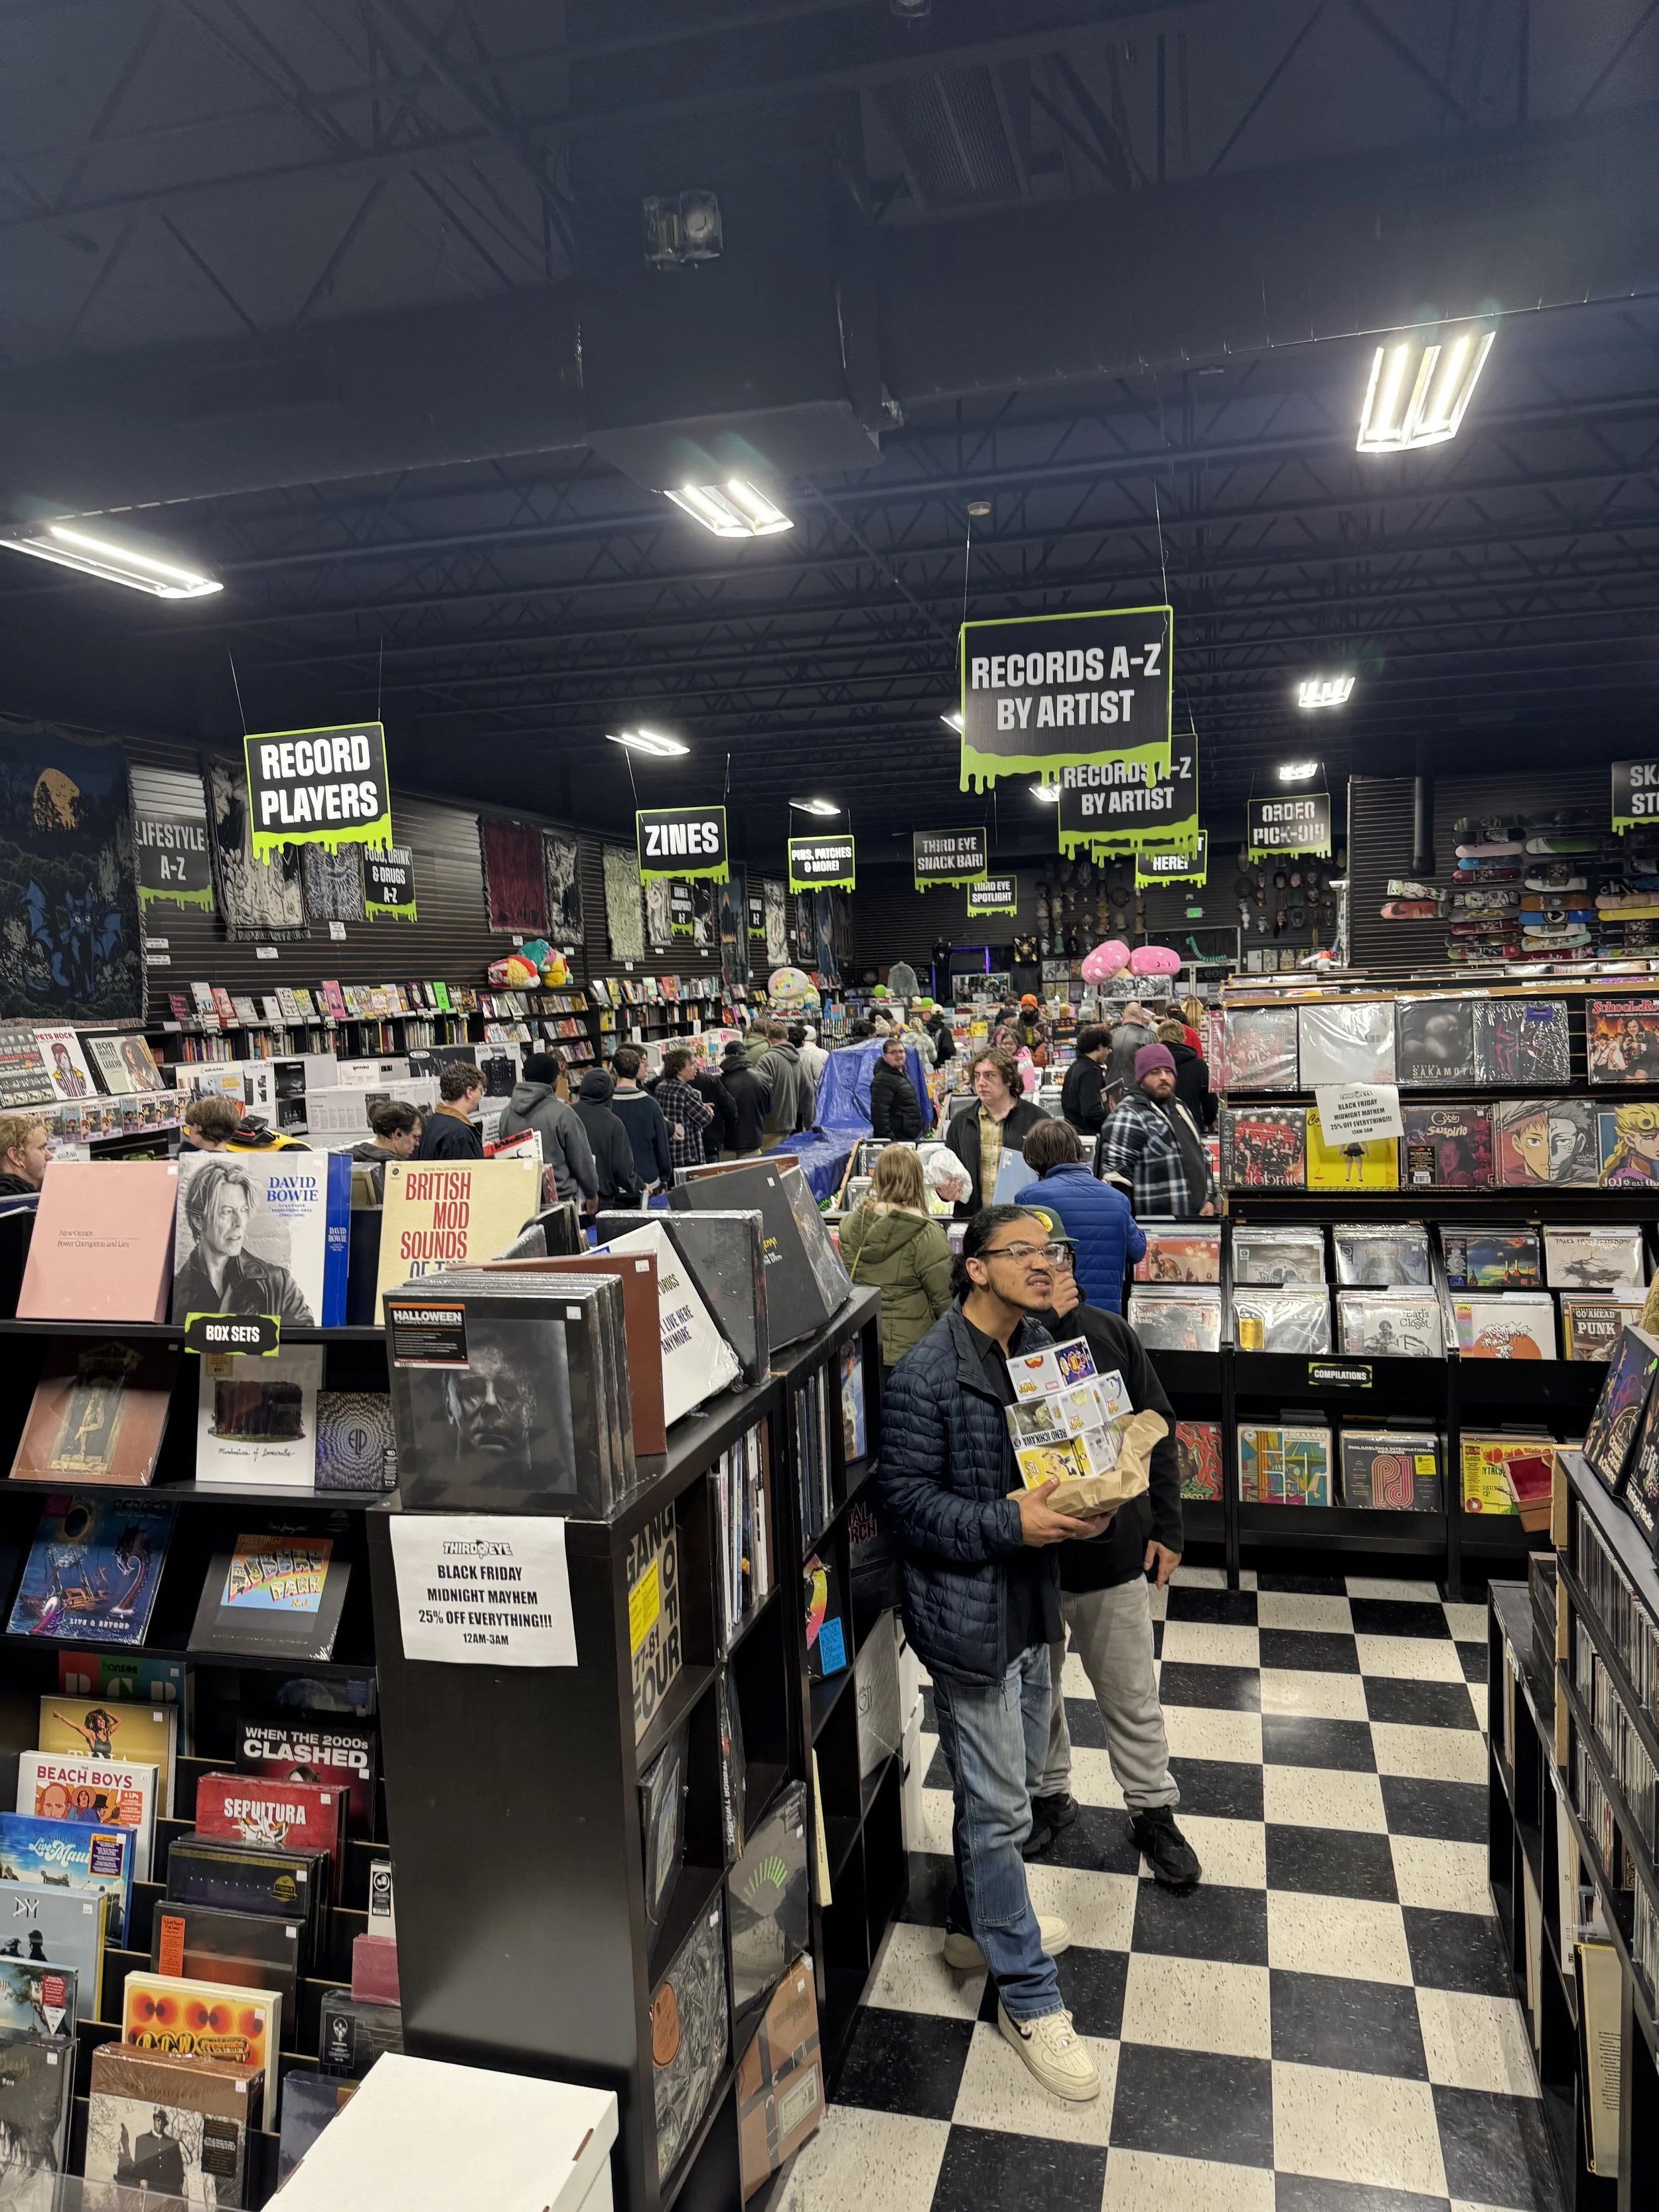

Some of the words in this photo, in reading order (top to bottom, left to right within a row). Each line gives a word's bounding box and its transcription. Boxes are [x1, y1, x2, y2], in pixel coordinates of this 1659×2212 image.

[971, 648, 1104, 690] RECORDS
[1110, 643, 1161, 679] A-Z
[997, 696, 1032, 731] BY
[1037, 689, 1135, 729] ARTIST
[260, 735, 370, 779] RECORD
[1630, 764, 1659, 786] SK
[261, 780, 378, 826] PLAYERS
[1082, 793, 1106, 815] BY
[1108, 787, 1175, 813] ARTIST
[1262, 801, 1315, 822] ORDER
[135, 820, 206, 852] LIFESTYLE
[644, 822, 719, 856] ZINES
[922, 838, 956, 853] THIRD
[958, 837, 977, 851] EYE
[792, 849, 814, 861] PINS,
[815, 846, 852, 859] PATCHES
[917, 855, 956, 871] SNACK
[957, 853, 983, 868] BAR!
[161, 855, 186, 881] A-Z
[372, 865, 379, 882] &
[380, 866, 405, 885] DRUGS
[804, 861, 812, 873] &
[812, 860, 839, 872] MORE!
[384, 887, 398, 903] A-Z
[997, 881, 1011, 891] EYE
[972, 892, 1012, 903] SPOTLIGHT
[1592, 1001, 1634, 1014] School
[1412, 1067, 1474, 1076] SAKAMOTO
[1334, 1111, 1360, 1120] MIDNIGHT
[1362, 1107, 1385, 1116] MAYHEM
[1338, 1102, 1357, 1110] BLACK
[1358, 1099, 1377, 1108] FRIDAY
[1307, 1114, 1320, 1126] Co
[1354, 1116, 1392, 1127] EVERYTHING!!!
[269, 1176, 317, 1189] DAVID
[405, 1172, 472, 1201] BRITISH
[266, 1189, 319, 1202] BOWIE
[433, 1202, 469, 1229] MOD
[400, 1231, 467, 1260] SOUNDS
[659, 1273, 680, 1294] DRUGS
[393, 1310, 463, 1322] HALLOWEEN
[664, 1313, 679, 1332] LIVE
[678, 1305, 693, 1324] HERE
[206, 1324, 230, 1342] BOX
[231, 1325, 260, 1343] SETS
[1577, 1322, 1616, 1335] PUNK
[661, 1326, 692, 1355] ANYMORE
[1314, 1369, 1367, 1380] COMPILATIONS
[1022, 1431, 1051, 1446] ICHIKAWA
[1052, 1428, 1067, 1441] RENO
[443, 1541, 477, 1555] THIRD
[486, 1542, 513, 1556] EYE
[437, 1564, 478, 1580] BLACK
[480, 1566, 522, 1581] FRIDAY
[270, 1576, 321, 1603] PARK
[427, 1588, 484, 1603] MIDNIGHT
[488, 1590, 538, 1605] MAYHEM
[99, 1620, 129, 1629] BEYOND
[419, 1609, 444, 1624] 25%
[446, 1611, 465, 1625] OFF
[469, 1613, 553, 1628] EVERYTHING!!!
[463, 1633, 509, 1645] 12AM-3AM
[246, 1726, 287, 1741] WHEN
[291, 1731, 319, 1744] THE
[322, 1735, 368, 1749] 2000s
[243, 1739, 368, 1769] CLASHED
[37, 1765, 87, 1783] BEACH
[92, 1772, 133, 1789] BOYS
[224, 1797, 306, 1826] SEPULTURA
[29, 1838, 51, 1856] Live
